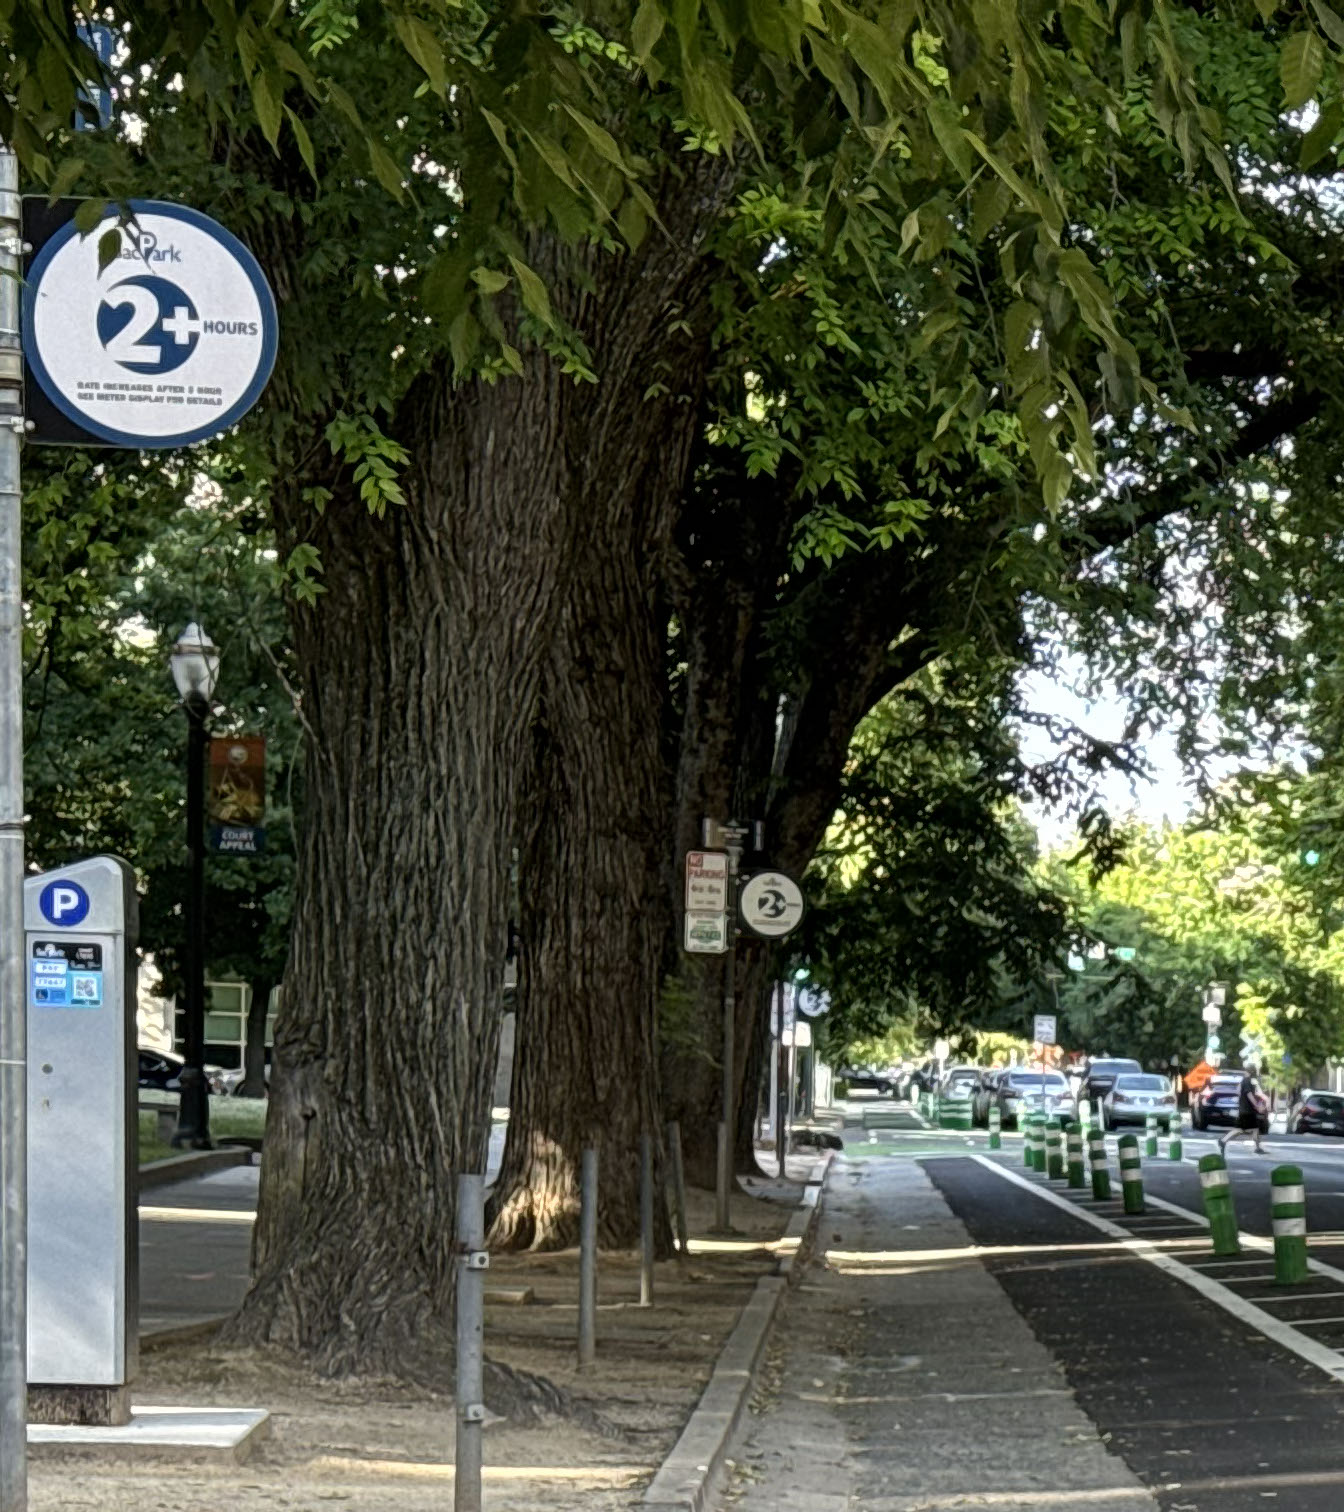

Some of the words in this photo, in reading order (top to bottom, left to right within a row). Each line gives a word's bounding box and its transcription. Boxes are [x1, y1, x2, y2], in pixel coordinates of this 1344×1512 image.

[115, 231, 183, 263] acPark
[99, 283, 200, 365] 2+
[203, 320, 259, 337] HOURS
[77, 381, 101, 391] RATE
[156, 384, 185, 394] AFTER
[96, 393, 127, 402] METER
[221, 831, 255, 840] COURT
[52, 887, 79, 919] P
